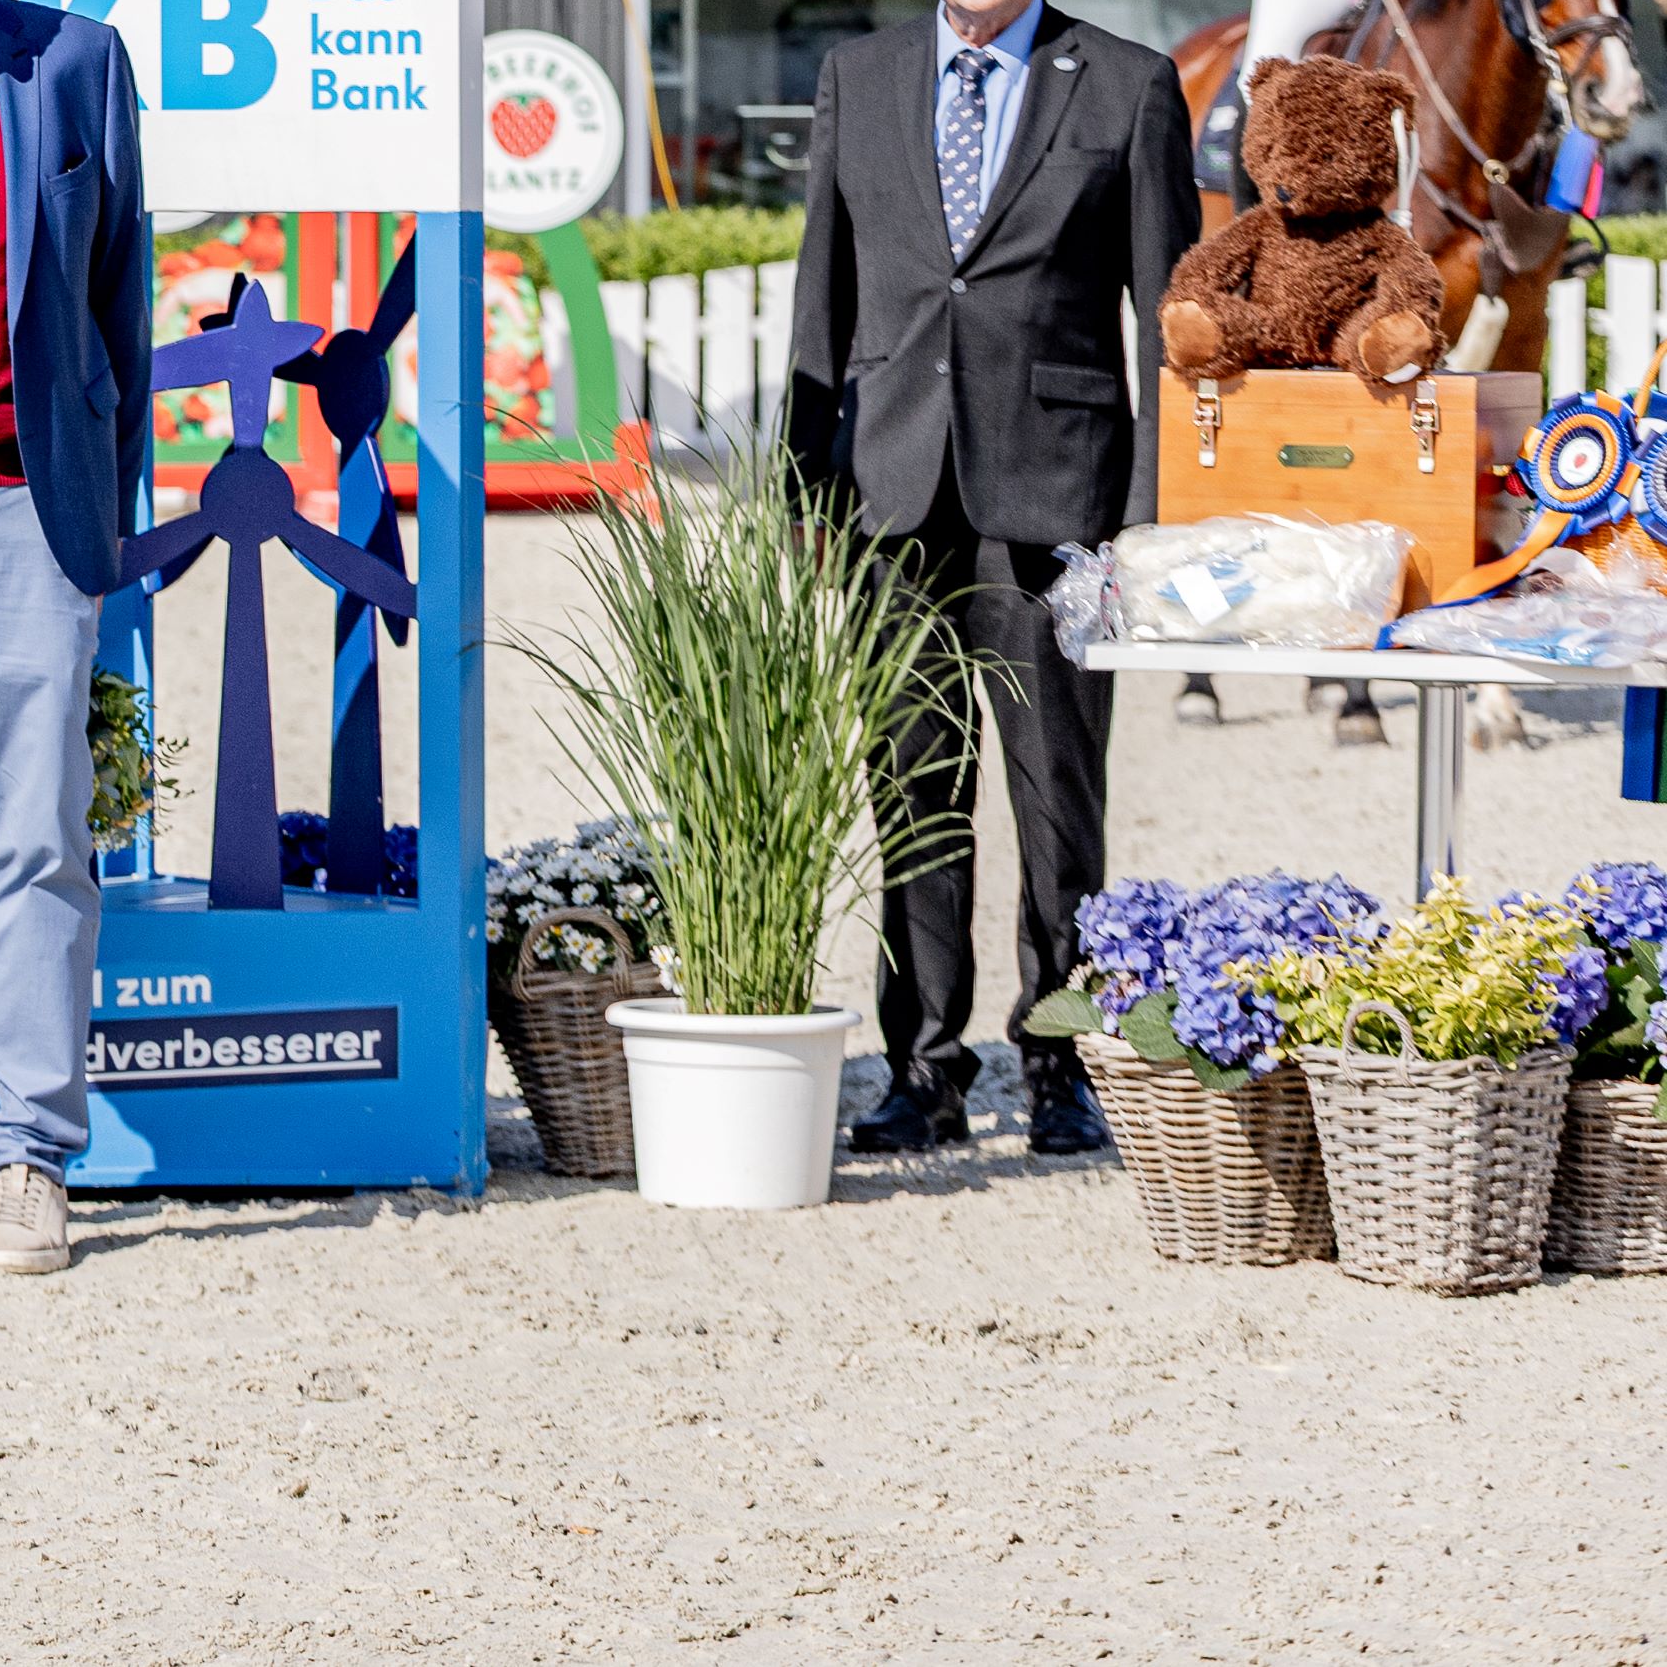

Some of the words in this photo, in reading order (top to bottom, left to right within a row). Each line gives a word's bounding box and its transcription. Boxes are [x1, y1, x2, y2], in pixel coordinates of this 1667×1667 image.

[309, 13, 423, 55] kann
[309, 68, 428, 111] Bank
[486, 54, 600, 133] BEERHOF
[486, 169, 582, 191] LANTZ
[114, 972, 213, 1007] zum
